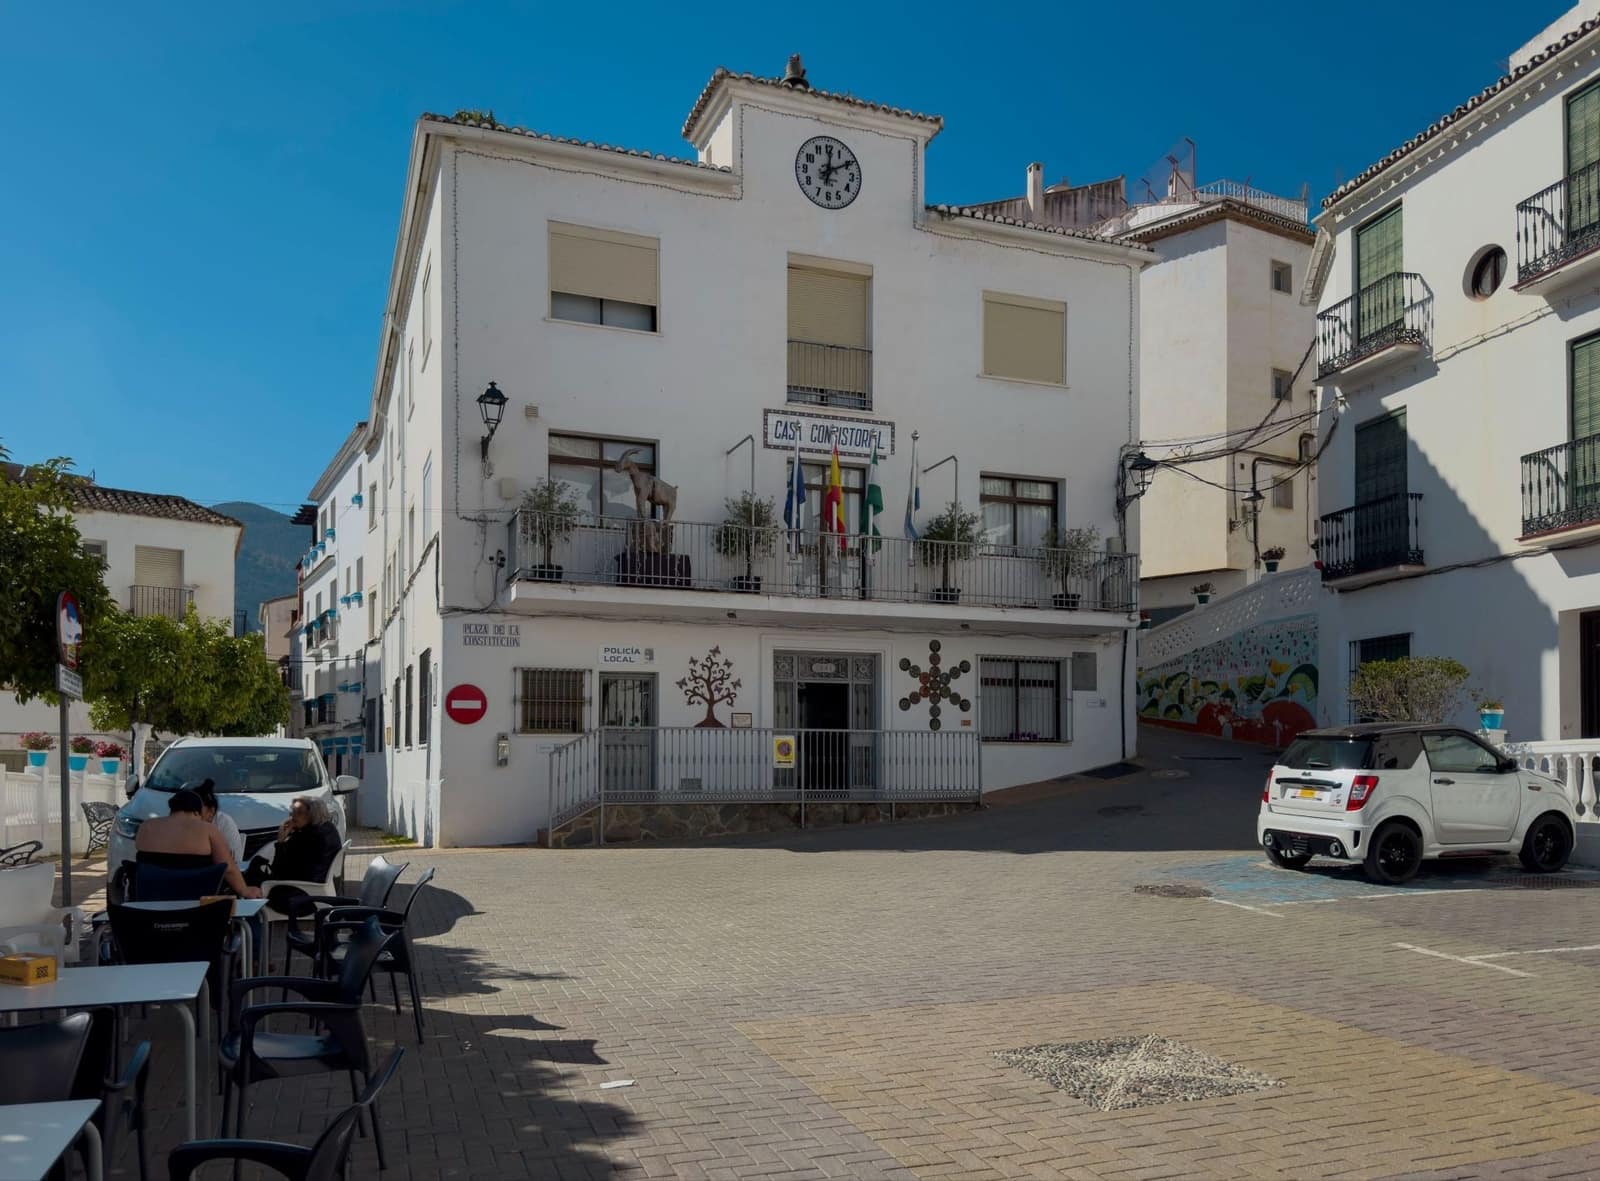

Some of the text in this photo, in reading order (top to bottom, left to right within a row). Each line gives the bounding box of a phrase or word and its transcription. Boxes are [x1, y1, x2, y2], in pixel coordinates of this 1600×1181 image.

[815, 145, 822, 155] 11
[825, 144, 834, 154] 12
[806, 153, 815, 163] 10
[802, 164, 808, 173] 9
[806, 176, 812, 185] 8
[848, 173, 854, 182] 3
[816, 187, 821, 196] 7
[844, 184, 850, 192] 4
[826, 192, 832, 201] 6
[836, 190, 842, 200] 5
[810, 424, 885, 449] CONISTORIL
[463, 623, 489, 634] PLAZA
[493, 624, 505, 635] DE
[604, 646, 640, 655] POLICÍA
